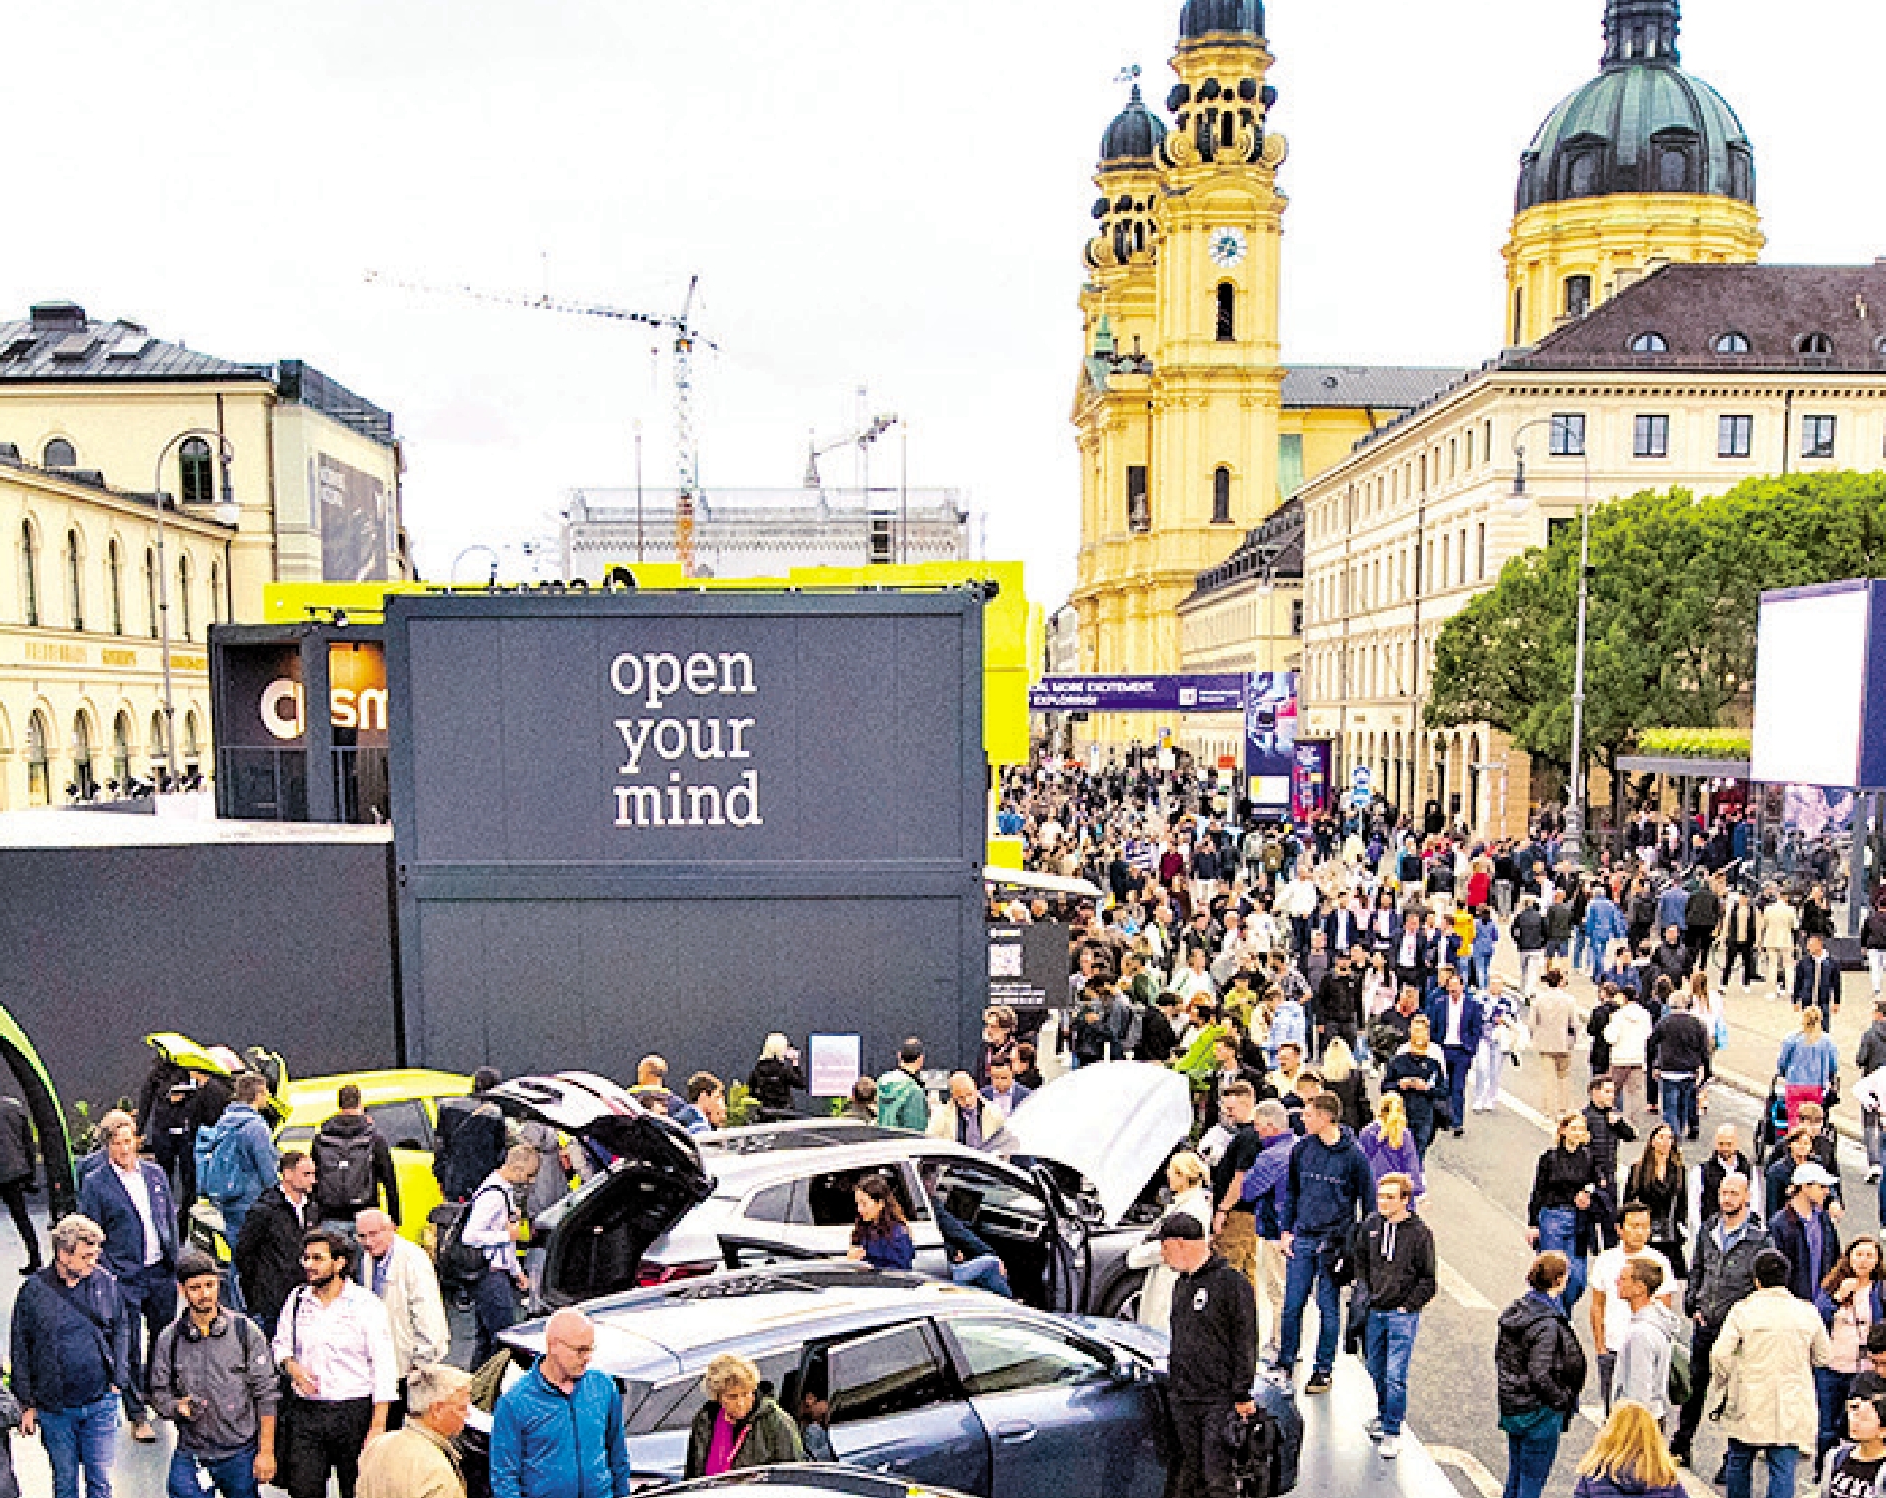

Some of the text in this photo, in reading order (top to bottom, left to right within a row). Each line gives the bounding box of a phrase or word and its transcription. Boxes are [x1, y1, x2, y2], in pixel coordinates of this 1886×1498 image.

[610, 652, 758, 708] open
[613, 718, 756, 774] your
[612, 769, 764, 827] mind
